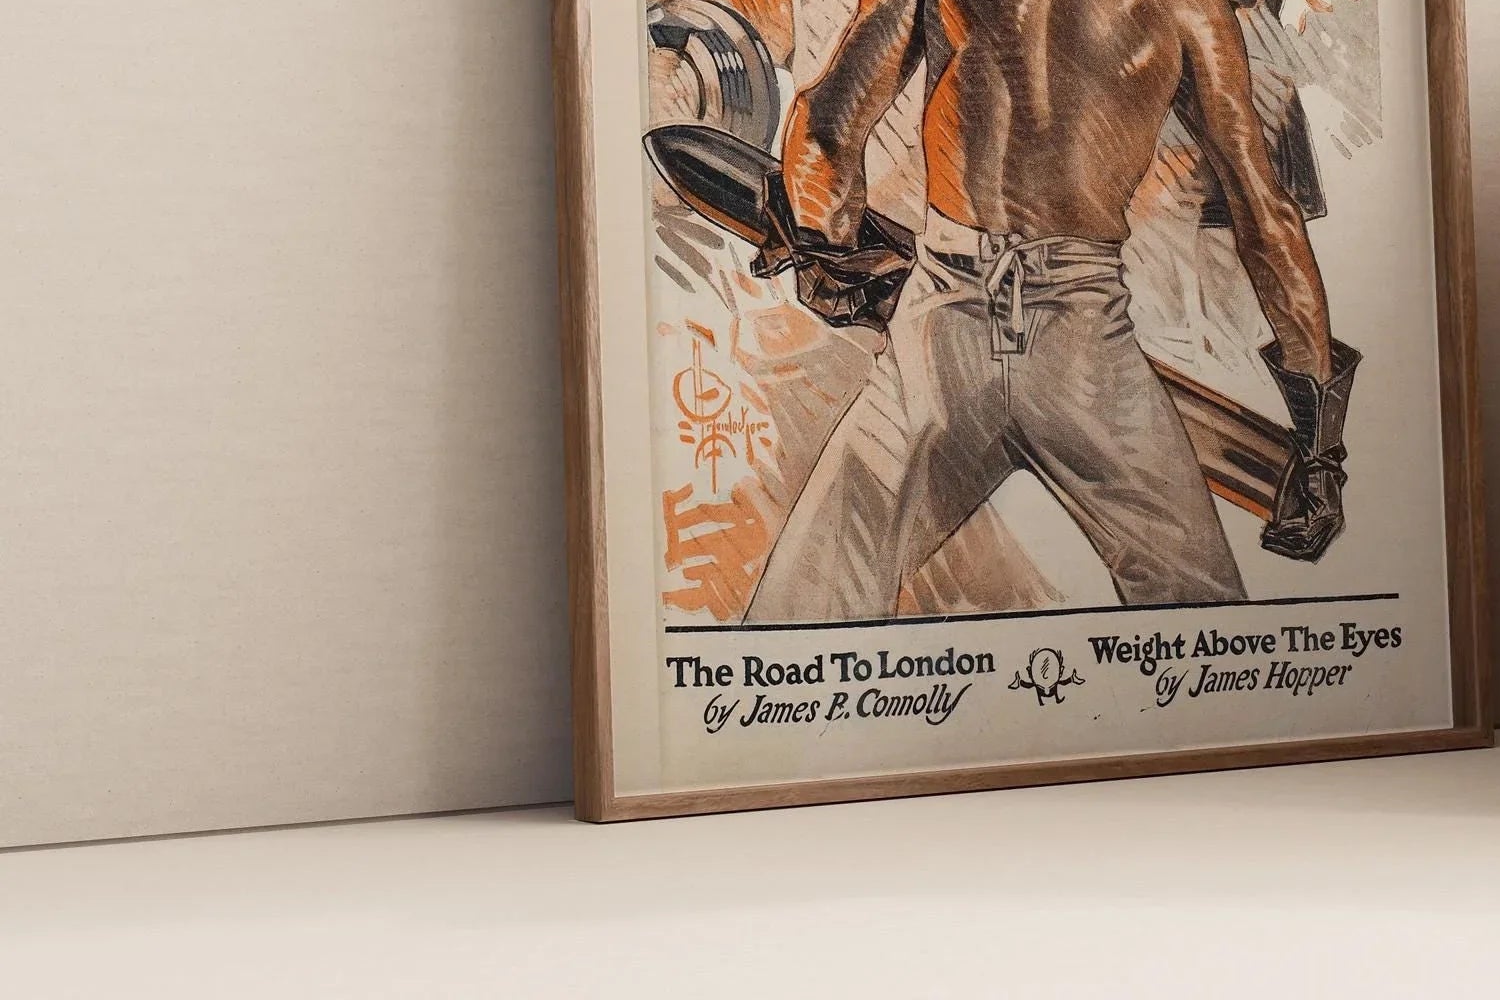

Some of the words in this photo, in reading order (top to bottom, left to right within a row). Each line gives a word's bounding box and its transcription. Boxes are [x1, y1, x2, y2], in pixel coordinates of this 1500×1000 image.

[666, 656, 734, 690] The
[743, 653, 826, 687] Road
[831, 651, 873, 683] To
[878, 648, 997, 680] London
[1088, 632, 1186, 676] Weight
[1190, 629, 1277, 658] Above
[1280, 625, 1335, 652] The
[1339, 623, 1403, 657] Eyes
[704, 693, 740, 734] by
[739, 694, 821, 728] James
[856, 682, 974, 726] Connolly
[1155, 666, 1188, 708] by
[1188, 664, 1260, 698] James
[1263, 661, 1353, 696] Hopper
